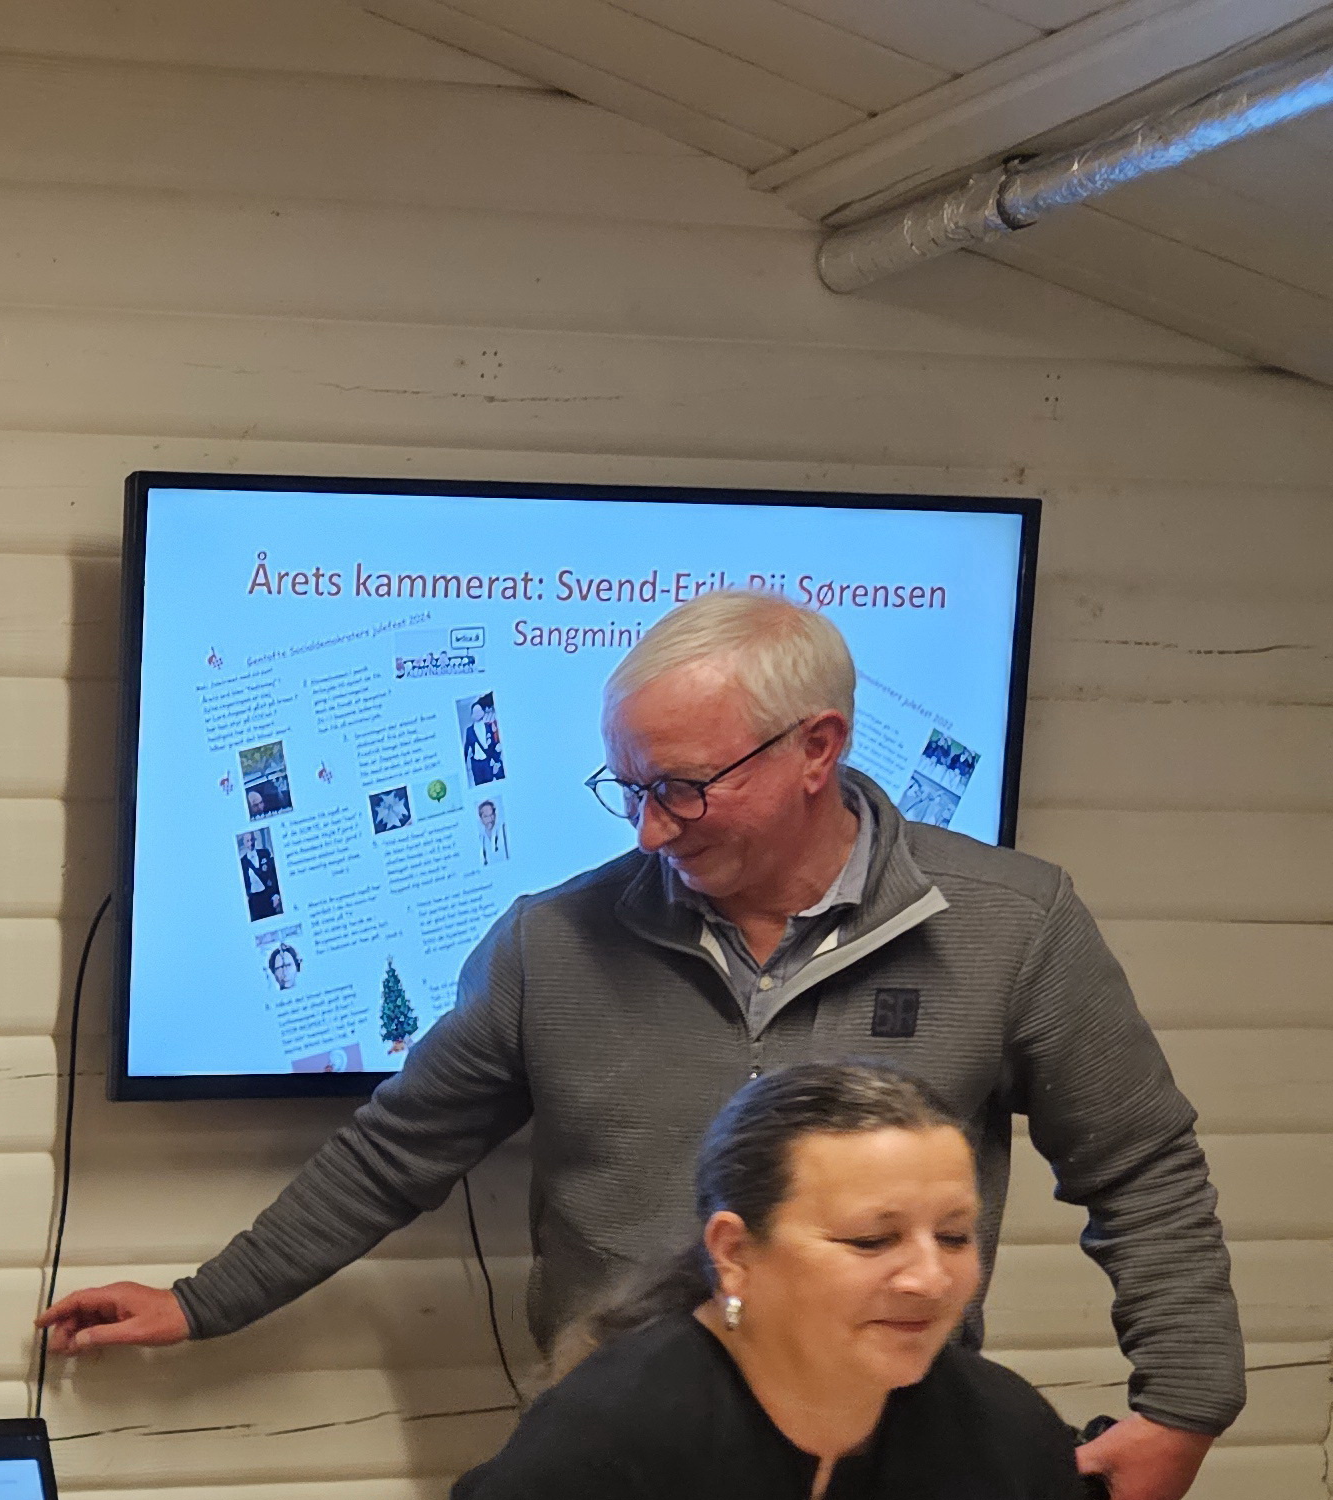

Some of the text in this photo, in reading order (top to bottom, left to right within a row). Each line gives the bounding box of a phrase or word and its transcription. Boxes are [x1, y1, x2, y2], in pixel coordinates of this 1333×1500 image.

[248, 551, 342, 597] Årets
[354, 562, 544, 602] kammerat:
[556, 569, 735, 603] Svend-Erik
[798, 575, 947, 611] Sørensen
[513, 619, 643, 654] Sangmini
